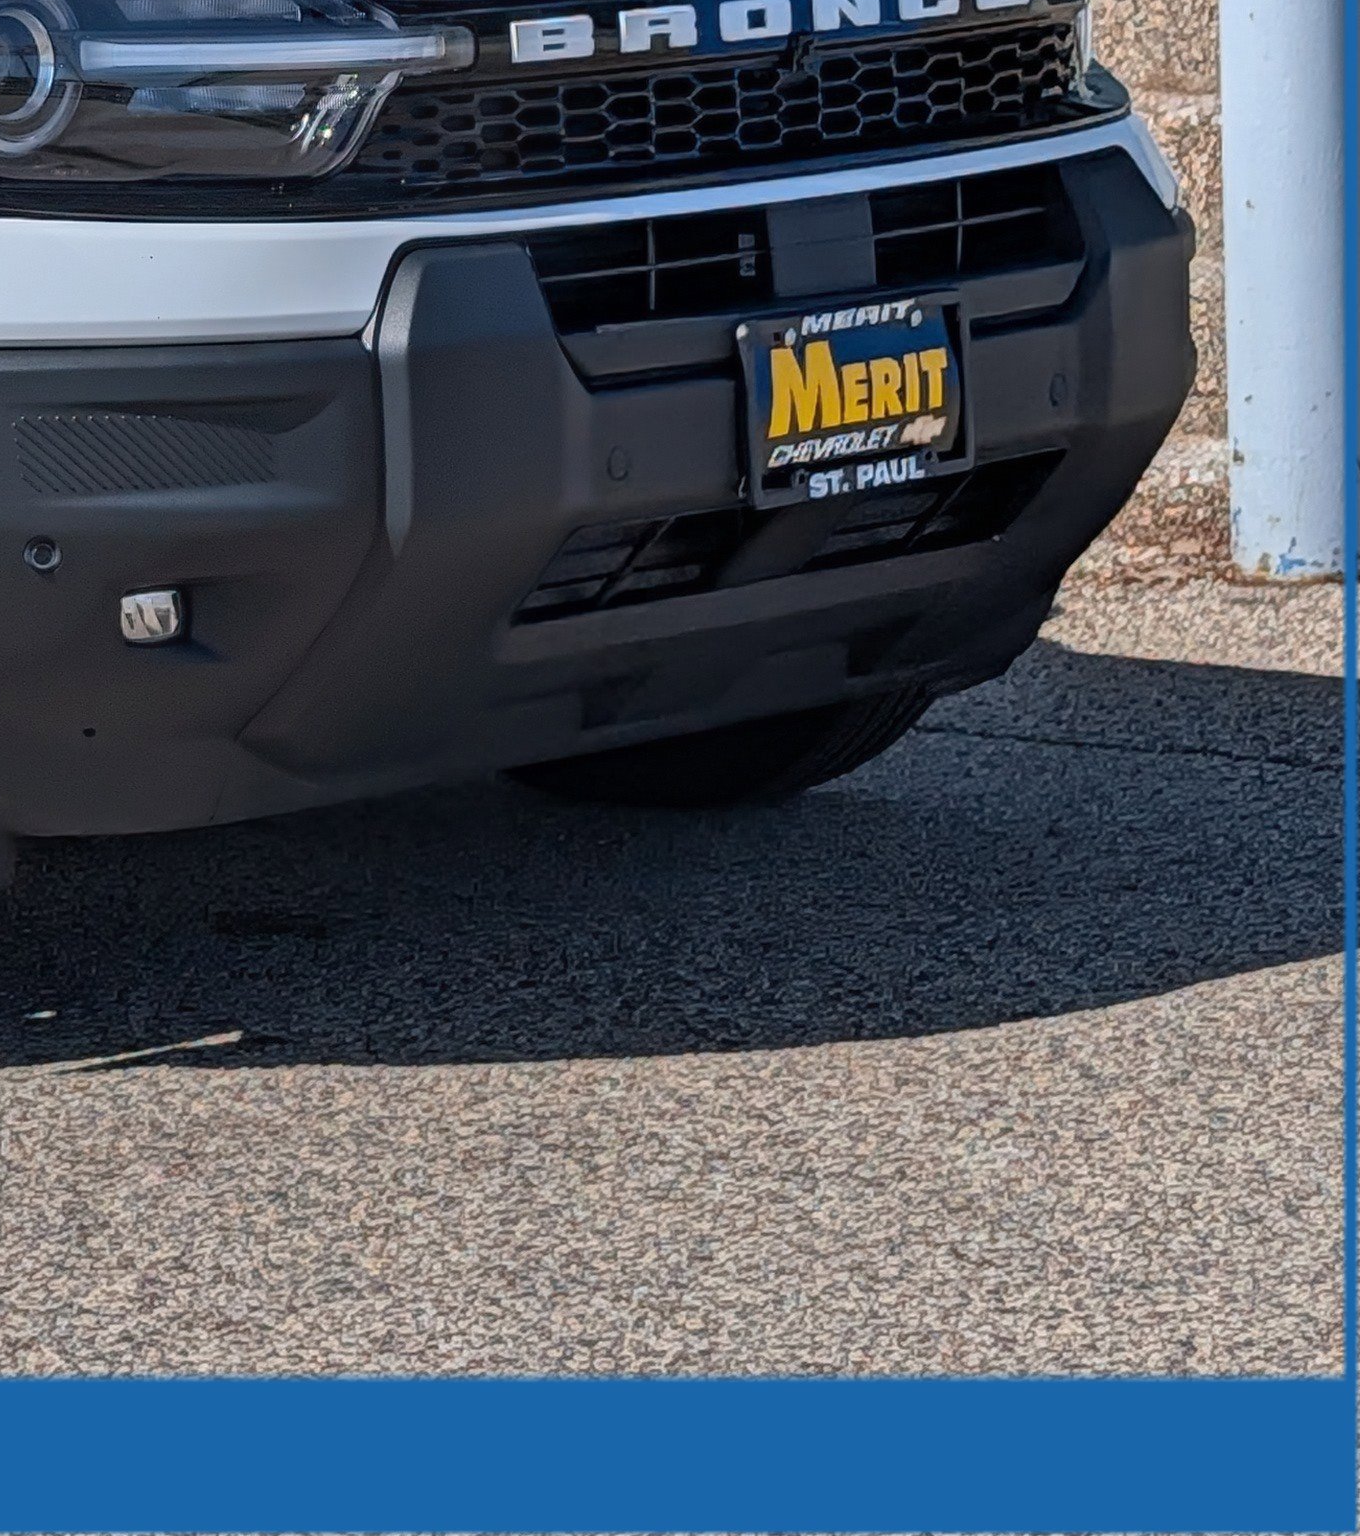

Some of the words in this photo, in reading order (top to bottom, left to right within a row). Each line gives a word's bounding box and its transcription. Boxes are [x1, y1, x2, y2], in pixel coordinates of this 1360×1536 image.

[801, 298, 916, 336] MERIT
[768, 424, 898, 469] CHEVROLET
[809, 469, 851, 499] ST.
[857, 456, 926, 490] PAUL
